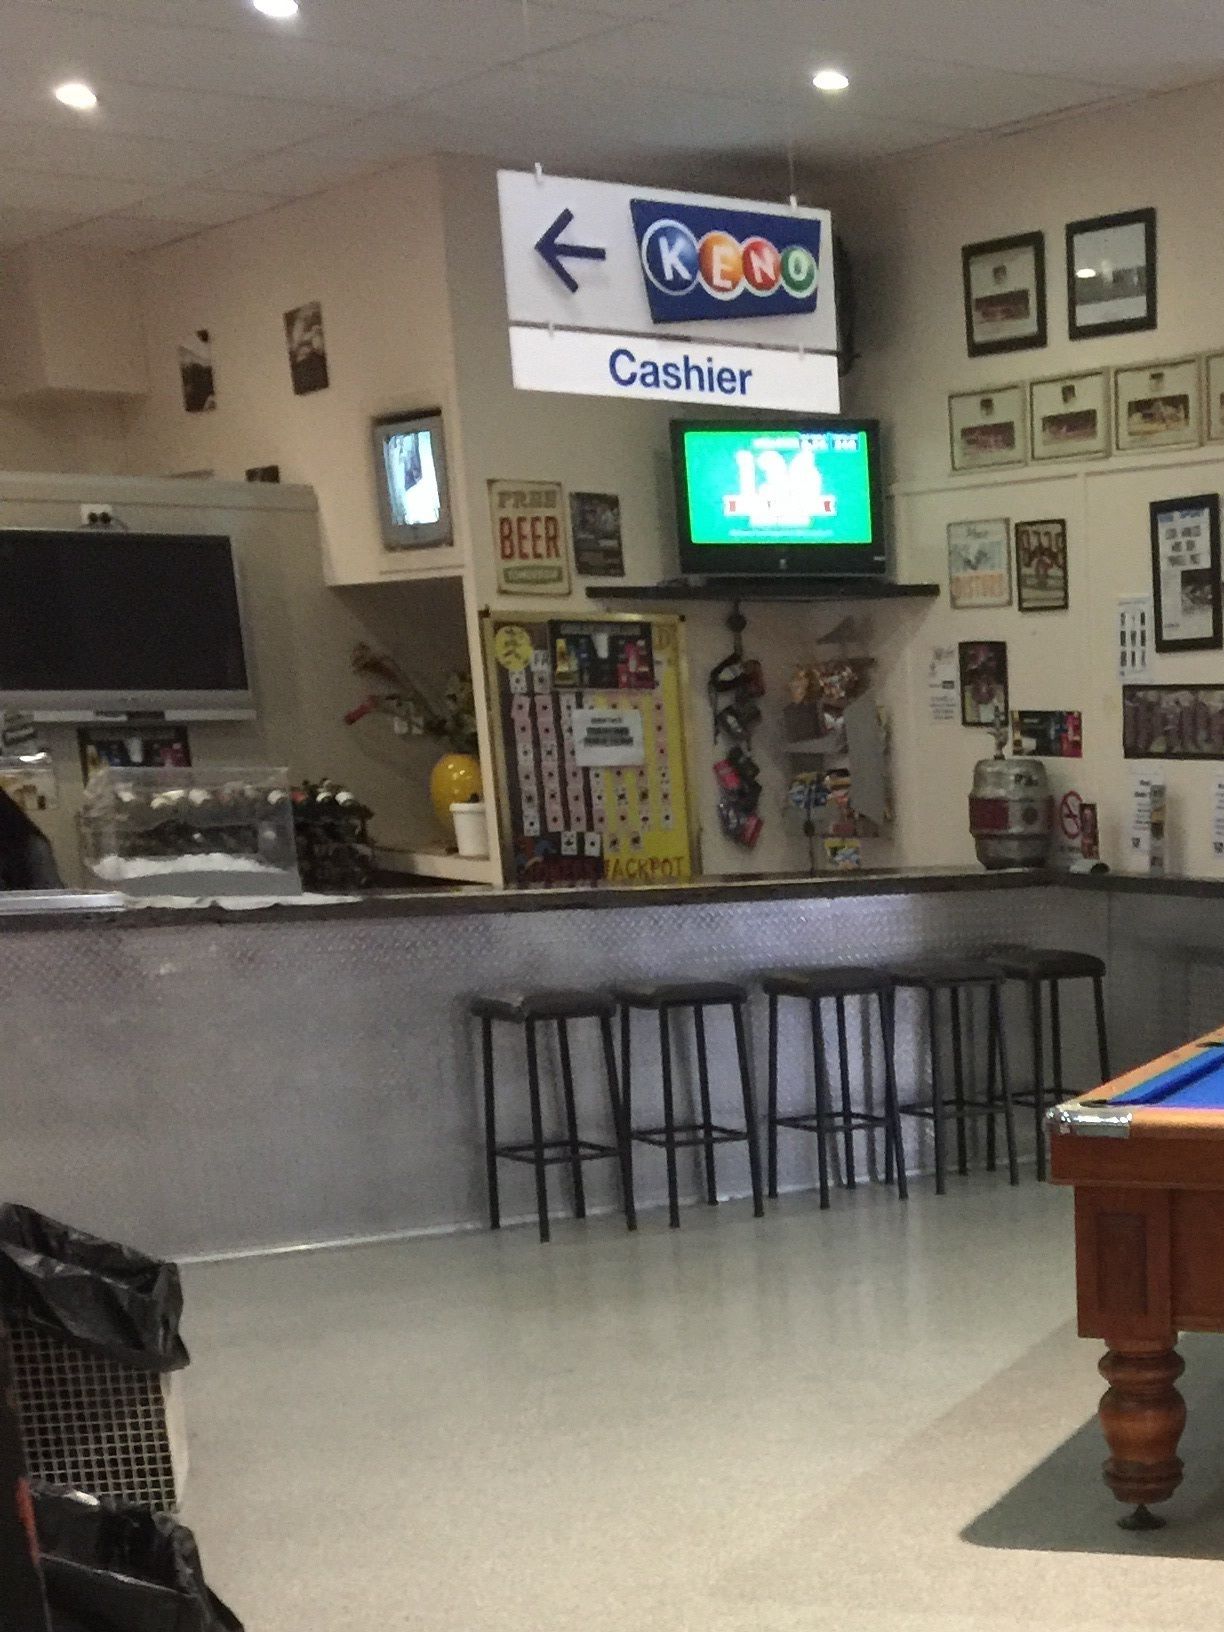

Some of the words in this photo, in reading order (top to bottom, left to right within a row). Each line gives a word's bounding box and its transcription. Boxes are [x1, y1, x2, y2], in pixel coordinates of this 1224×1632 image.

[654, 231, 809, 291] KENO
[608, 348, 753, 395] Cashier
[499, 515, 560, 560] BEER
